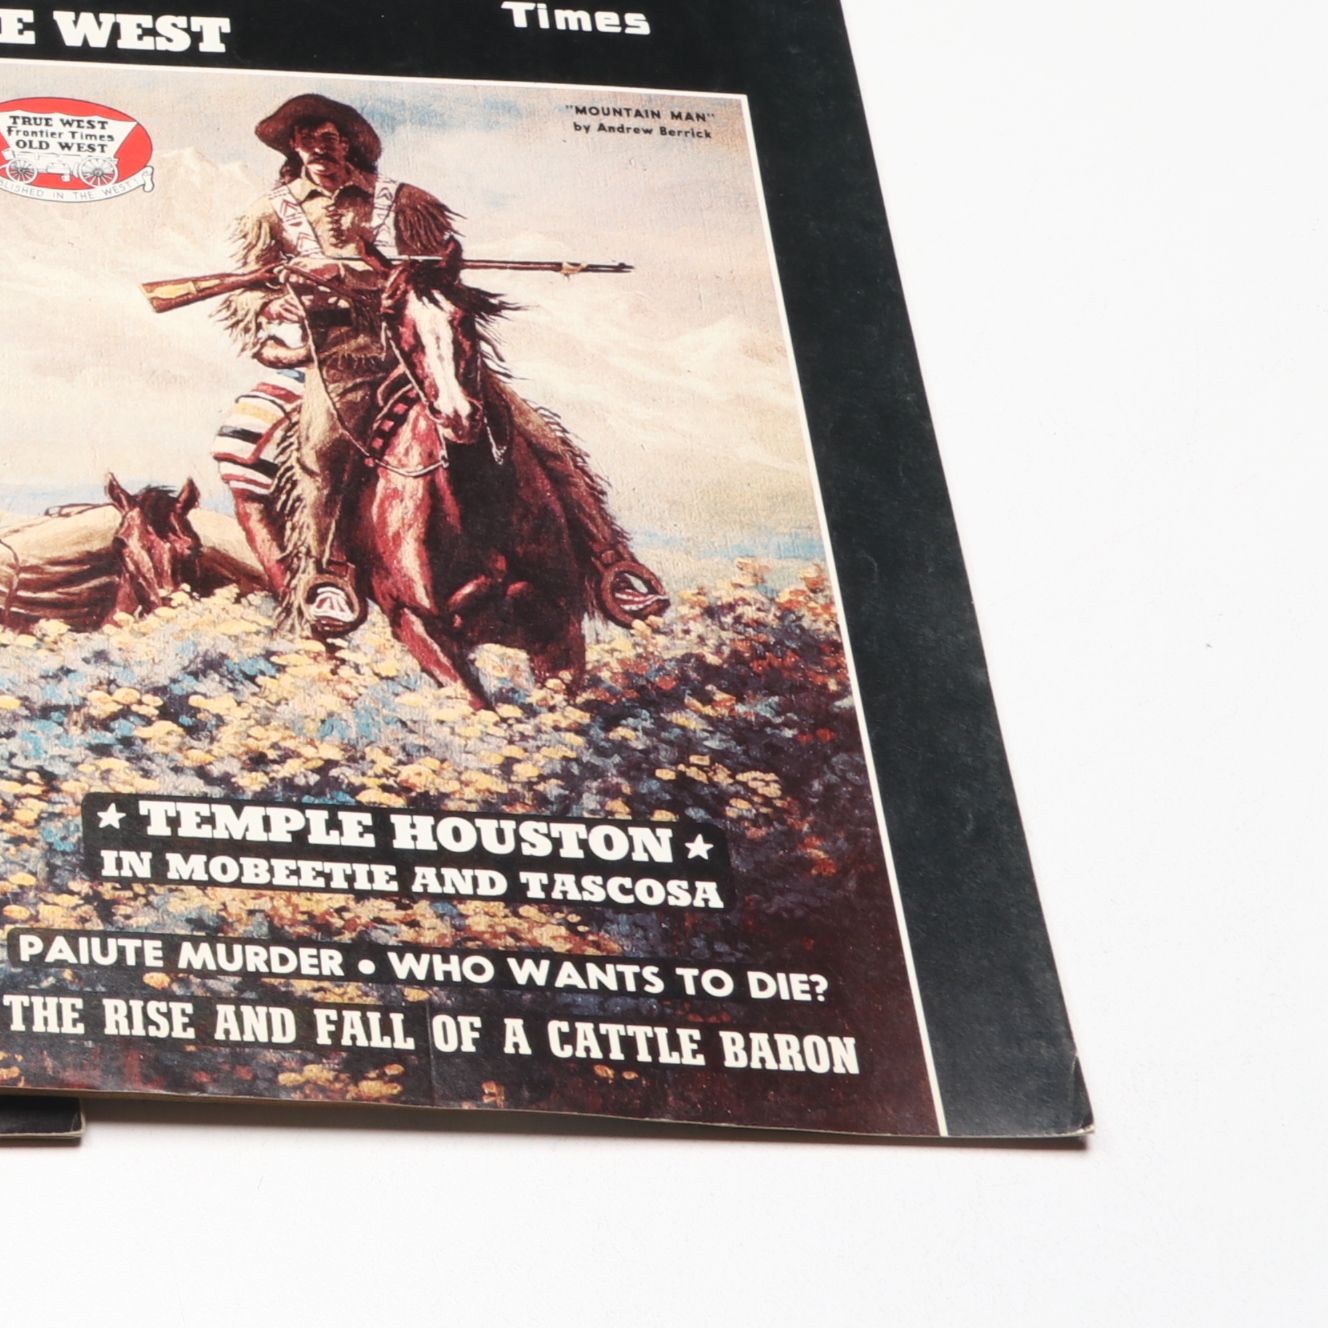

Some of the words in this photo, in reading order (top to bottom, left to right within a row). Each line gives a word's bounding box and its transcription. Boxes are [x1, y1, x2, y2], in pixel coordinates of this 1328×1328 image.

[53, 10, 231, 53] WEST
[501, 1, 651, 35] Times
[573, 122, 591, 134] by
[597, 123, 653, 135] Andrew
[660, 126, 712, 139] Berrick
[139, 800, 375, 847] TEMPLE
[390, 814, 673, 863] HOUSTON
[101, 850, 152, 879] IN
[165, 853, 398, 891] MOBEETIE
[413, 867, 507, 897] AND
[520, 872, 724, 909] TASCOSA
[20, 934, 164, 968] PAIUTE
[178, 941, 343, 976] MURDER
[387, 951, 494, 984] WHO
[507, 958, 665, 994] WANTS
[677, 968, 733, 997] TO
[747, 972, 828, 1001] DIE?
[3, 994, 85, 1034] THE
[103, 999, 196, 1039] RISE
[214, 1003, 296, 1044] AND
[313, 1008, 415, 1051] FALL
[432, 1014, 482, 1053] OF
[504, 1018, 532, 1055] A
[547, 1020, 706, 1066] CATTLE
[720, 1030, 860, 1074] BARON
